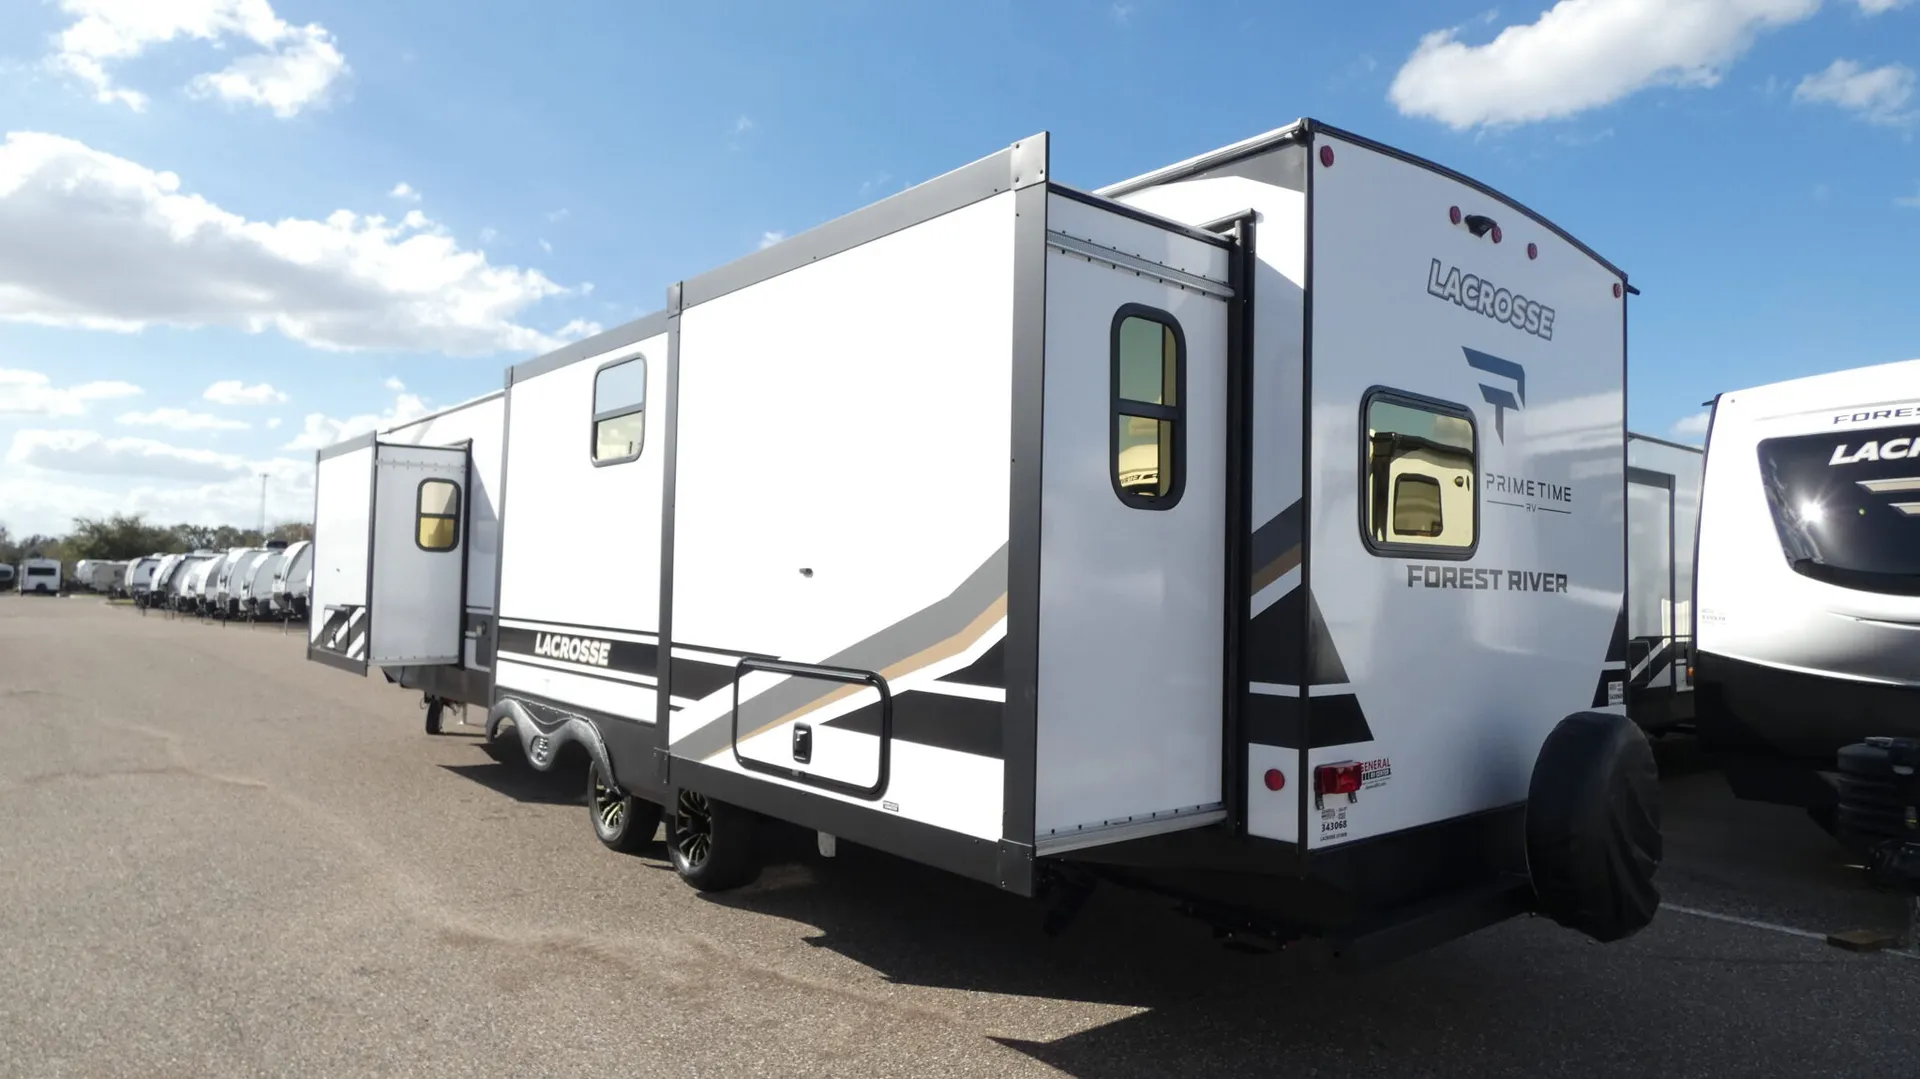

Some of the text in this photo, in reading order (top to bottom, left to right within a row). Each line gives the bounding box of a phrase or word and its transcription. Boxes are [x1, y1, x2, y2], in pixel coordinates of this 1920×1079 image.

[1427, 258, 1555, 341] LACROSSE
[1833, 407, 1920, 424] FORE
[1524, 502, 1537, 513] RV
[1406, 564, 1568, 594] FOREST RIVER
[534, 631, 612, 667] LACROSSE
[1321, 820, 1348, 833] 343068
